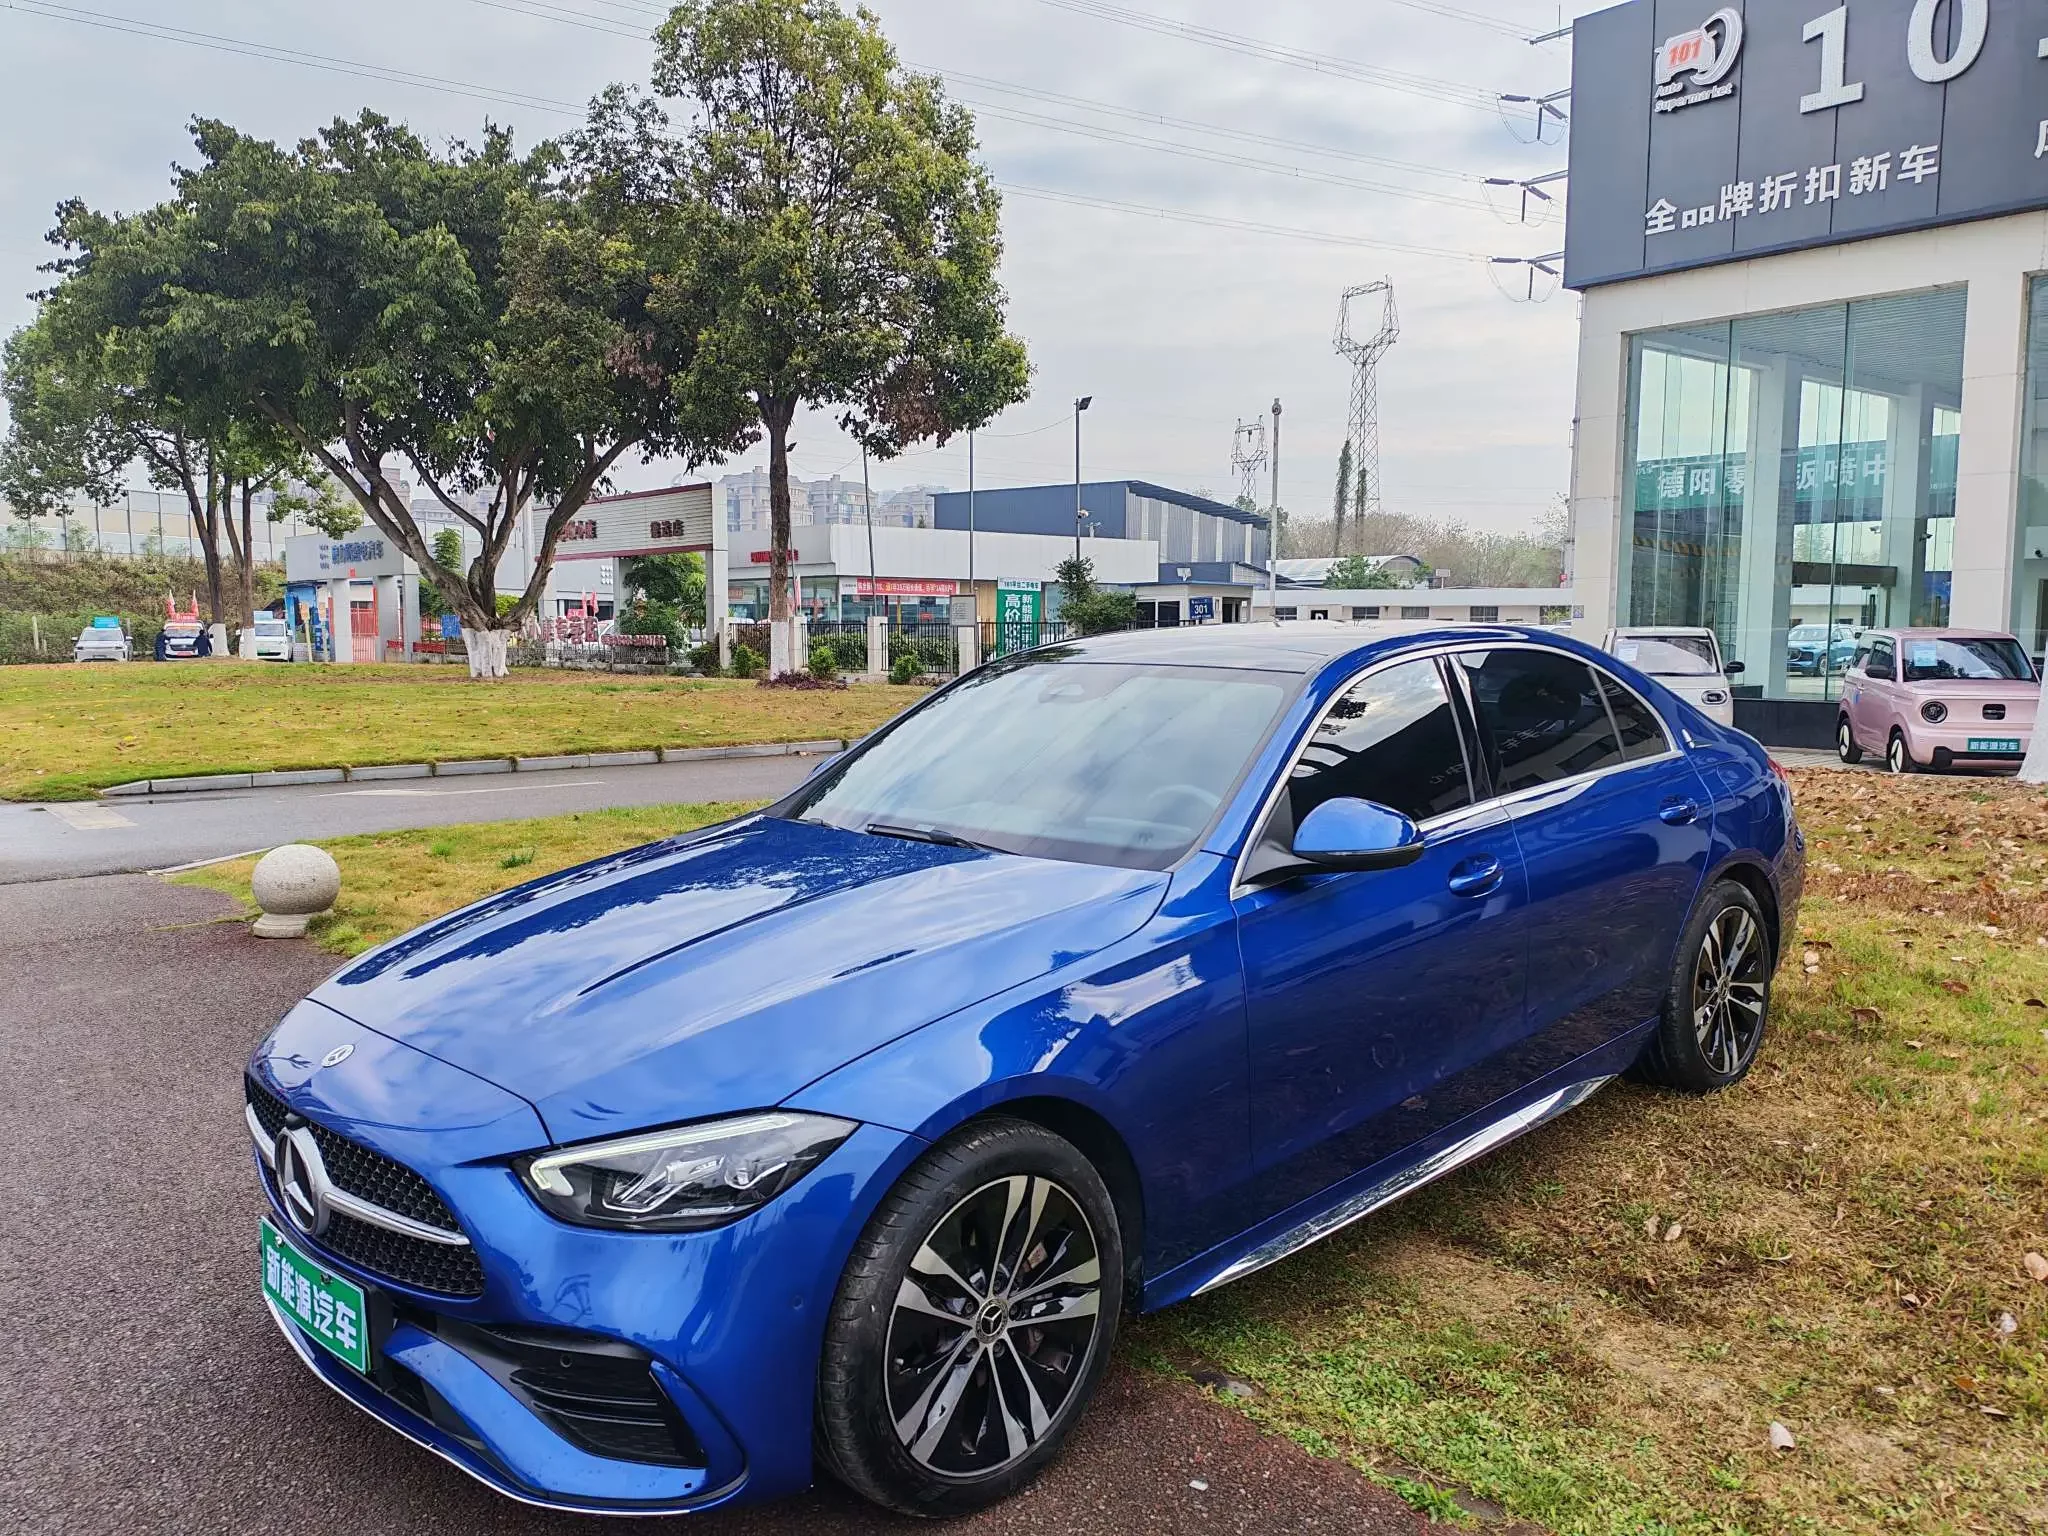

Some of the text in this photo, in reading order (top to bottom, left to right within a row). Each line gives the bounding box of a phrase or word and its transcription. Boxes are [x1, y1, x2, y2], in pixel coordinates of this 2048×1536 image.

[1669, 38, 1703, 66] 101
[1654, 82, 1684, 99] Auto
[1654, 82, 1734, 112] Supermarket
[1644, 143, 1940, 237] 全品牌折扣新车
[1194, 604, 1209, 614] 301
[1969, 741, 2018, 751] 新能源汽车
[265, 1244, 358, 1351] 新能源汽车
